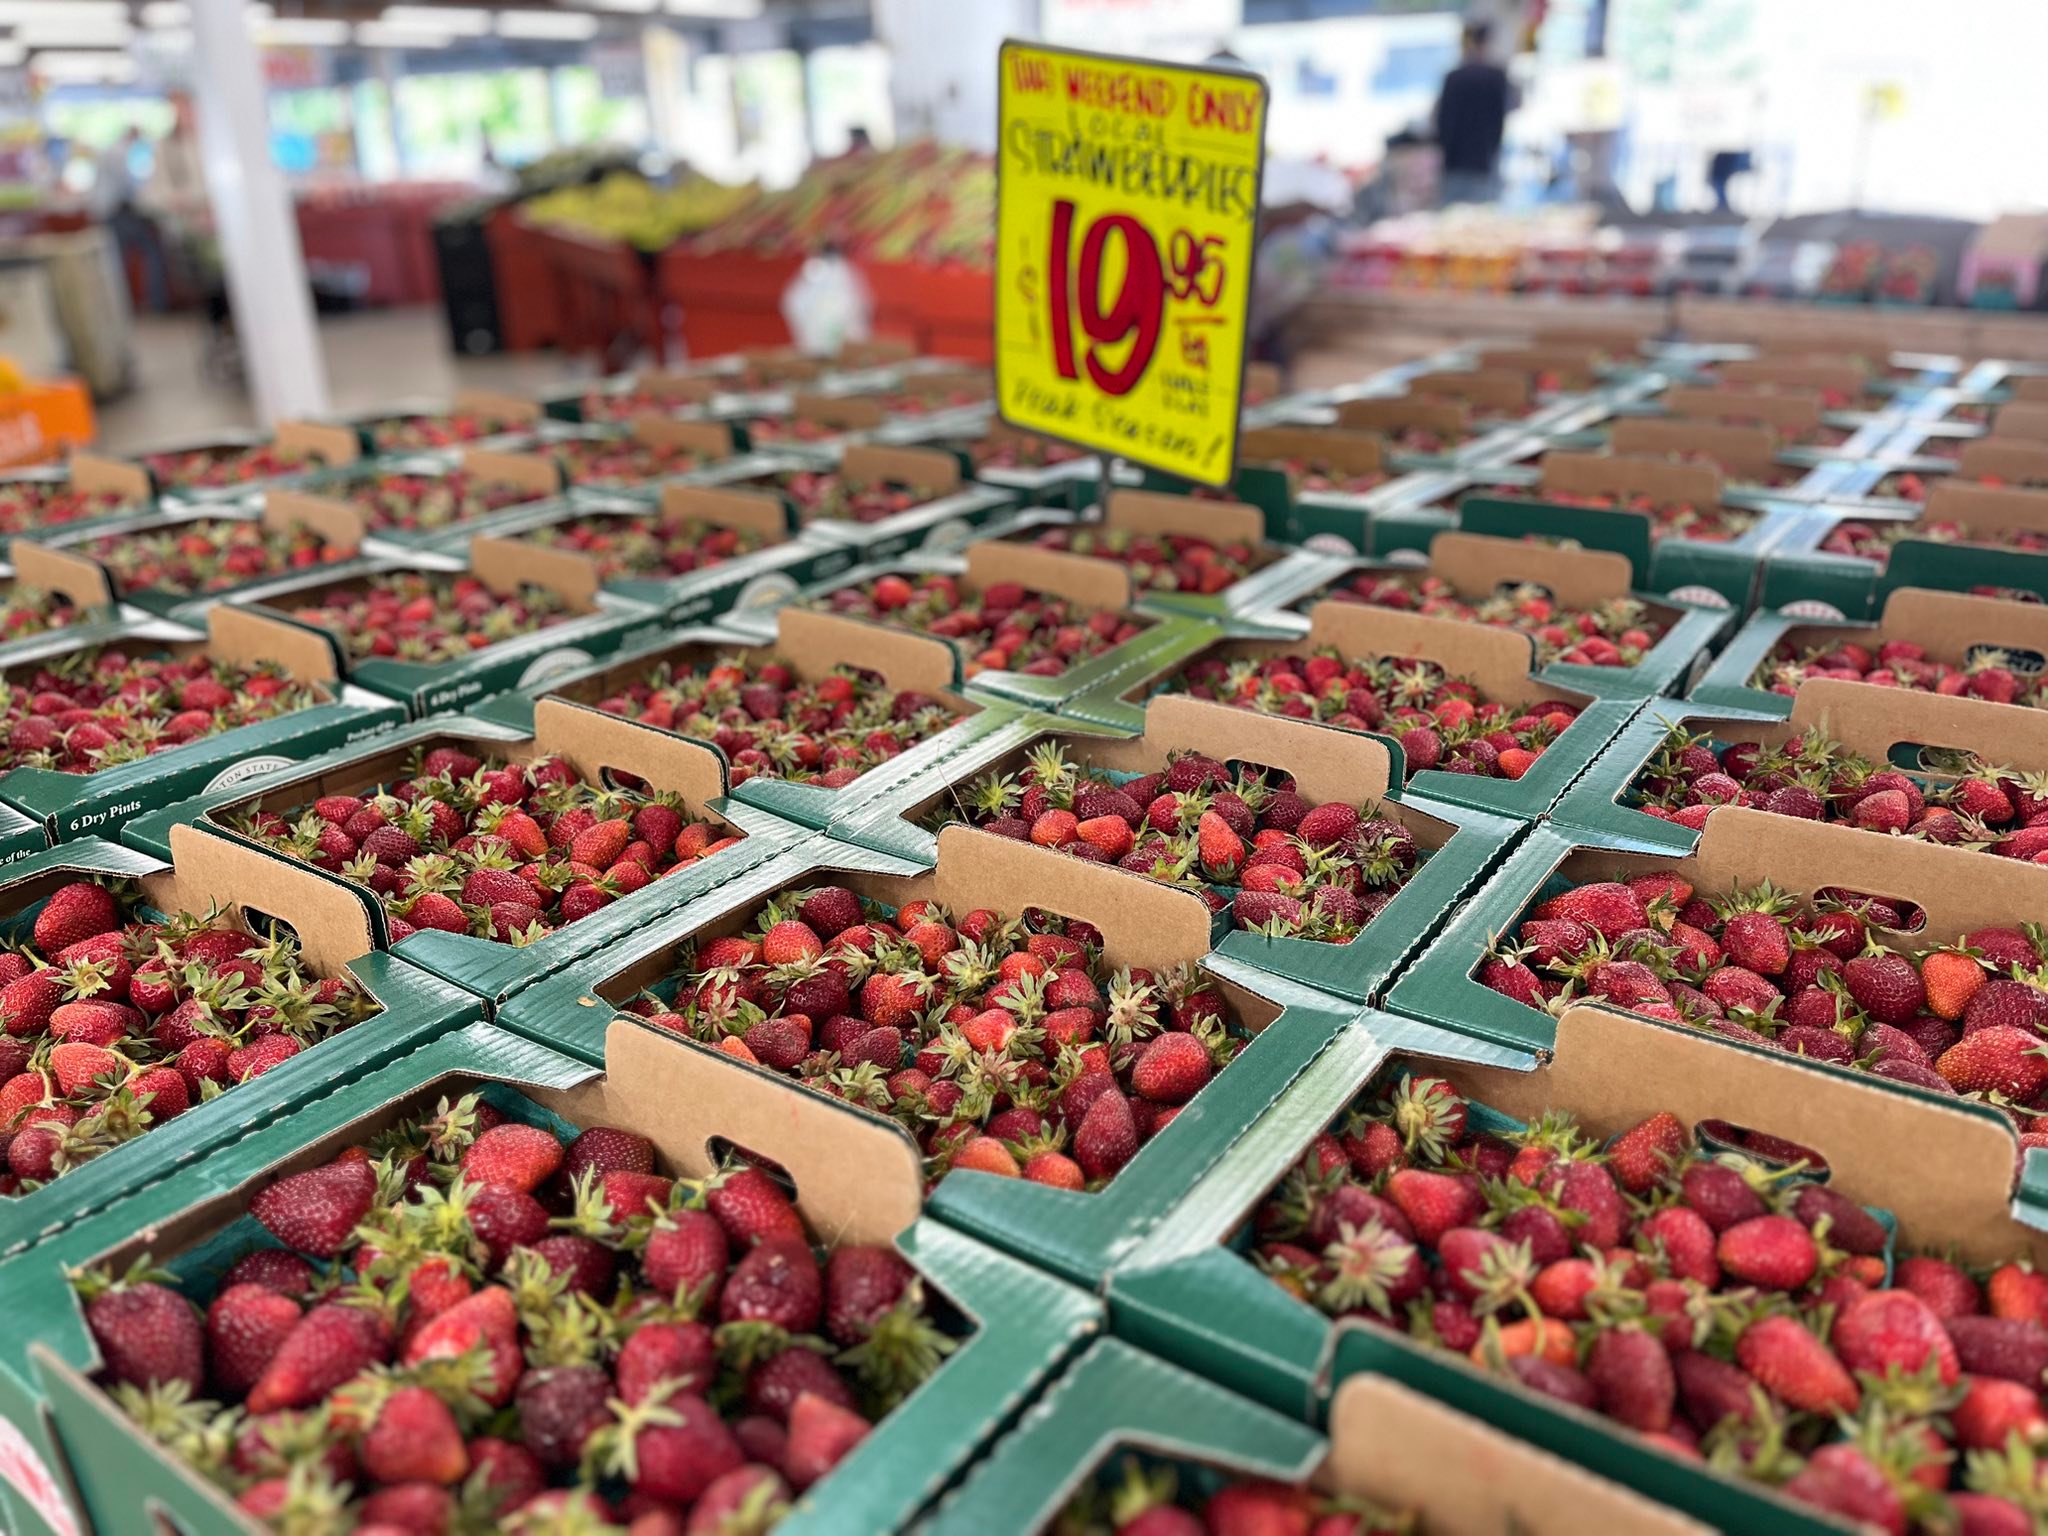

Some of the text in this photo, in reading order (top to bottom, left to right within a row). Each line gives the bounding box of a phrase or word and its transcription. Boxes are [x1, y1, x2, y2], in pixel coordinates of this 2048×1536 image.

[1064, 65, 1176, 118] WEEKEND
[1187, 81, 1261, 134] ONLY
[1008, 119, 1256, 223] STRAWBERRIES
[1049, 199, 1165, 396] 19
[70, 800, 142, 831] 6 Dry Pints
